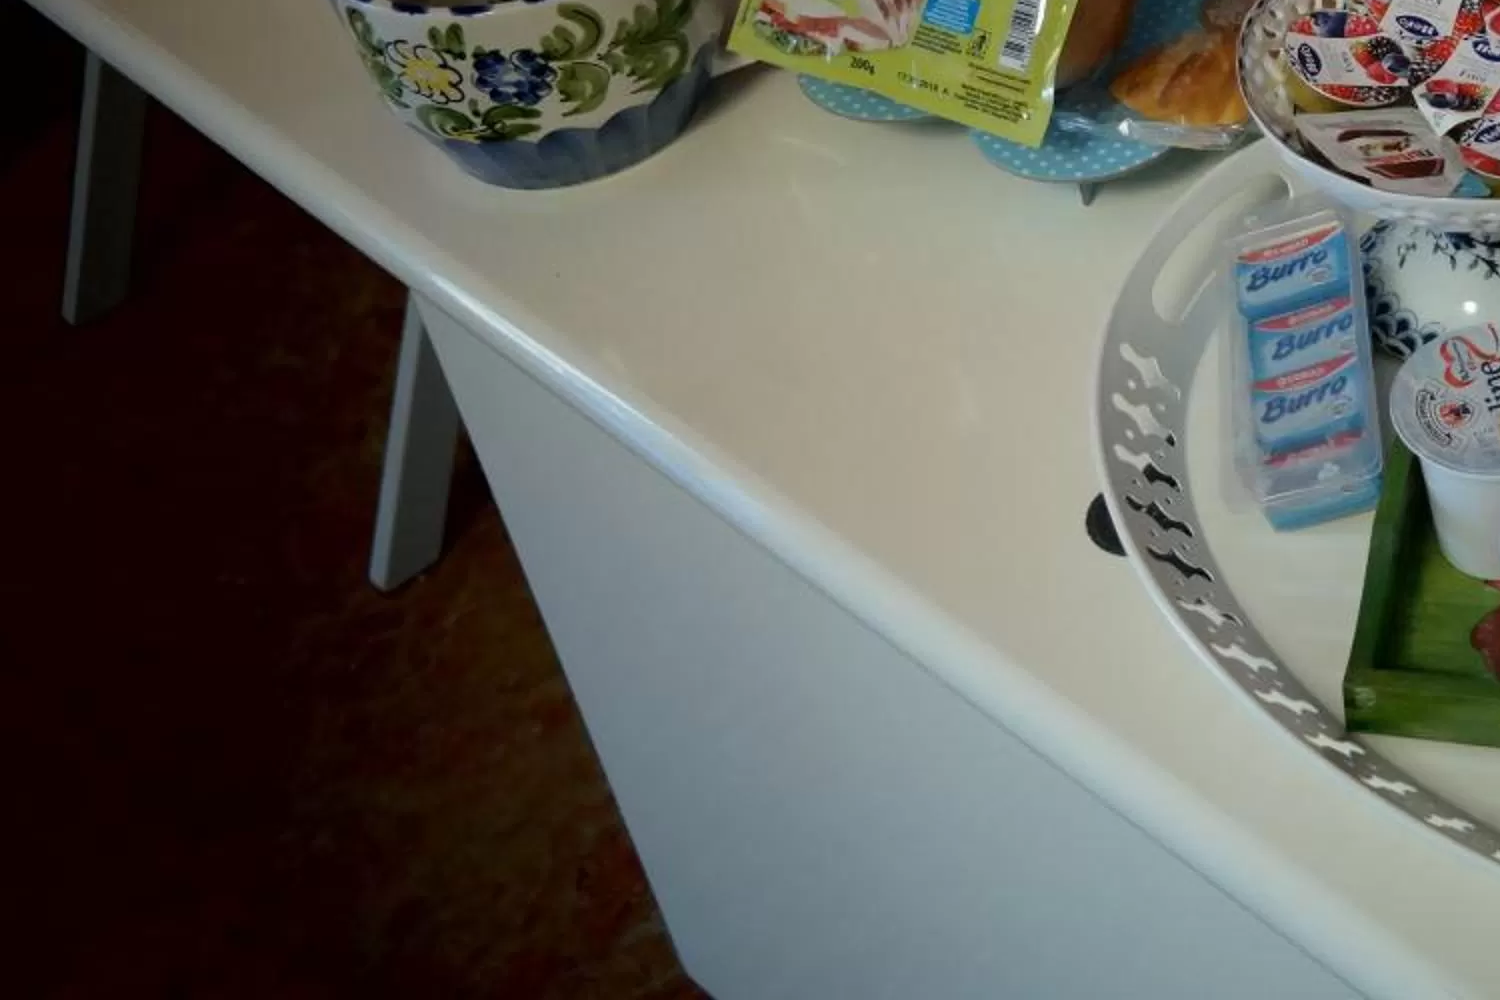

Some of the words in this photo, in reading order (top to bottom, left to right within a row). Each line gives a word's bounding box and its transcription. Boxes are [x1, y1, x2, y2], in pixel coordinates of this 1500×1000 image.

[1246, 249, 1328, 292] Burro
[1271, 312, 1353, 361] Burro
[1261, 375, 1348, 423] Burro
